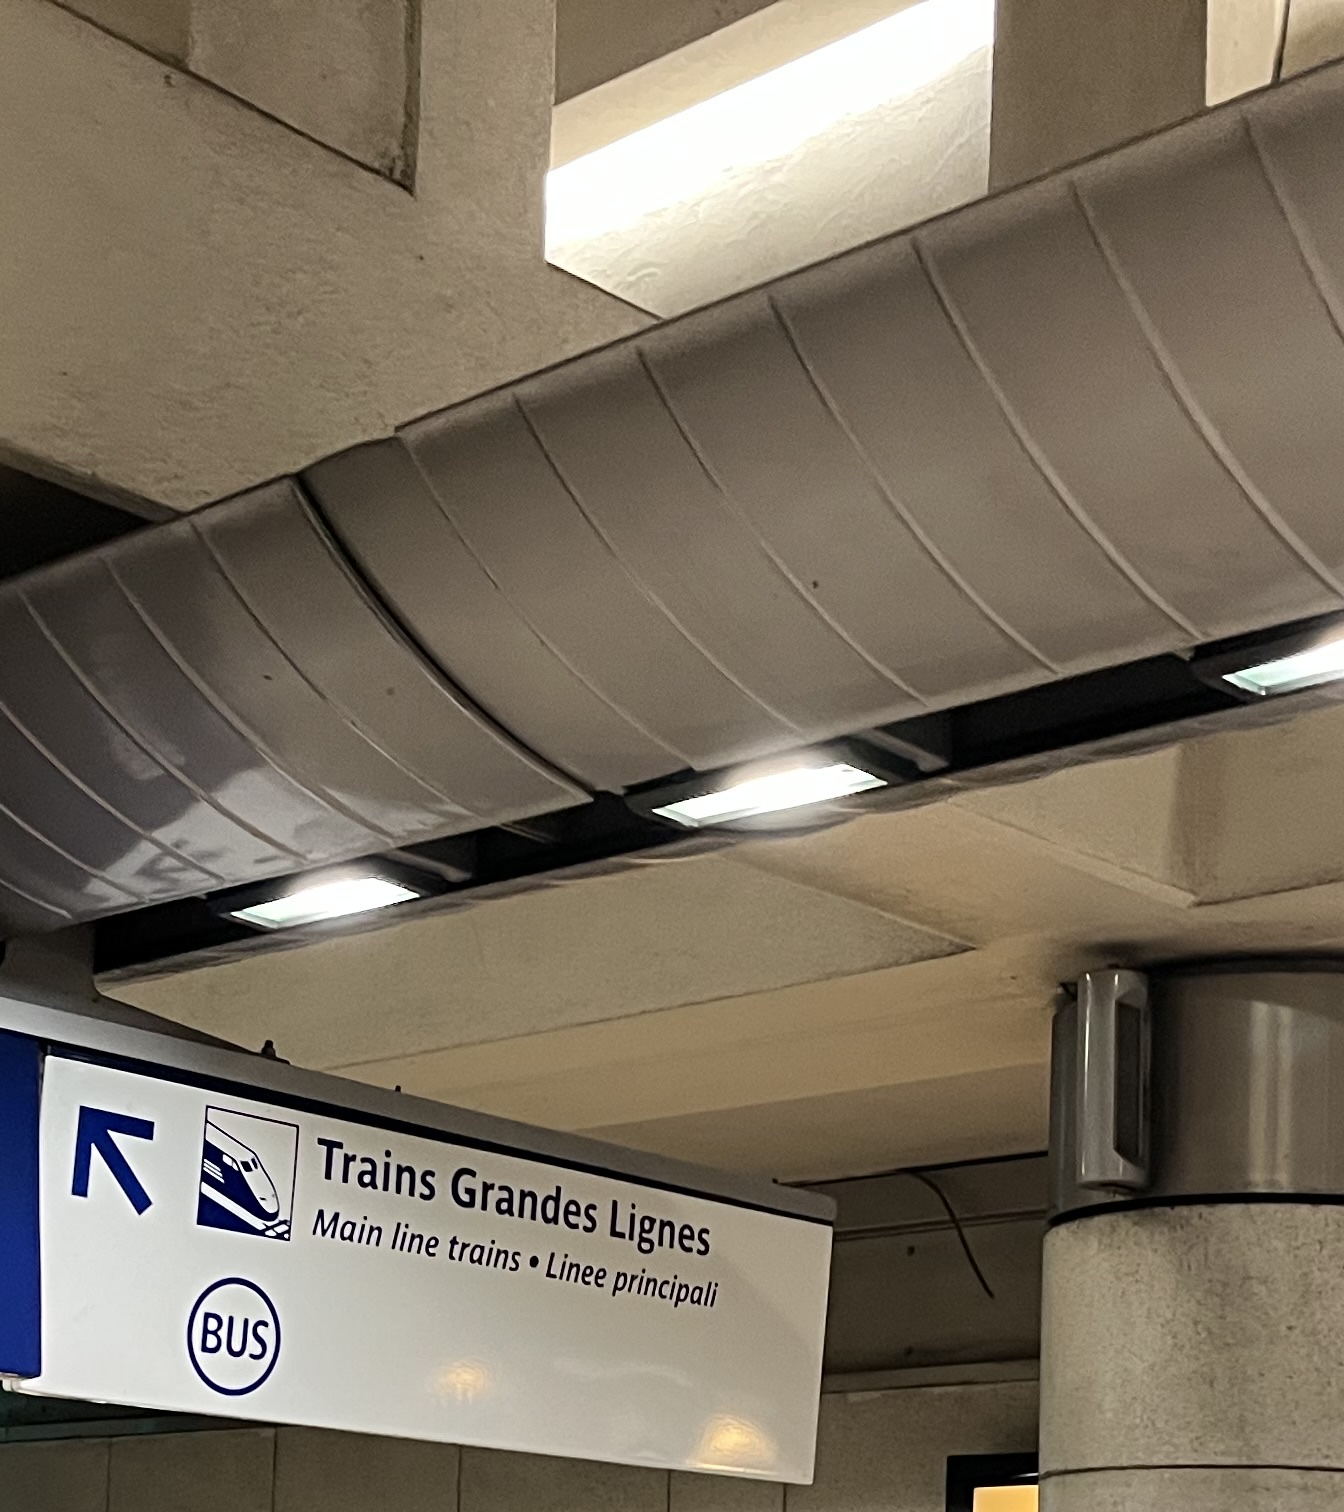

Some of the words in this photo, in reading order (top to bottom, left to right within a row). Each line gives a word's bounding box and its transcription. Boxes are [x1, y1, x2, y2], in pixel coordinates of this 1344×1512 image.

[317, 1137, 436, 1201] Trains
[451, 1167, 598, 1233] Grandes
[609, 1199, 711, 1256] Lignes
[312, 1208, 383, 1247] Main
[391, 1221, 440, 1257] line
[448, 1235, 522, 1272] trains
[545, 1252, 607, 1288] Linee
[611, 1268, 720, 1308] principali
[200, 1312, 270, 1362] BUS
